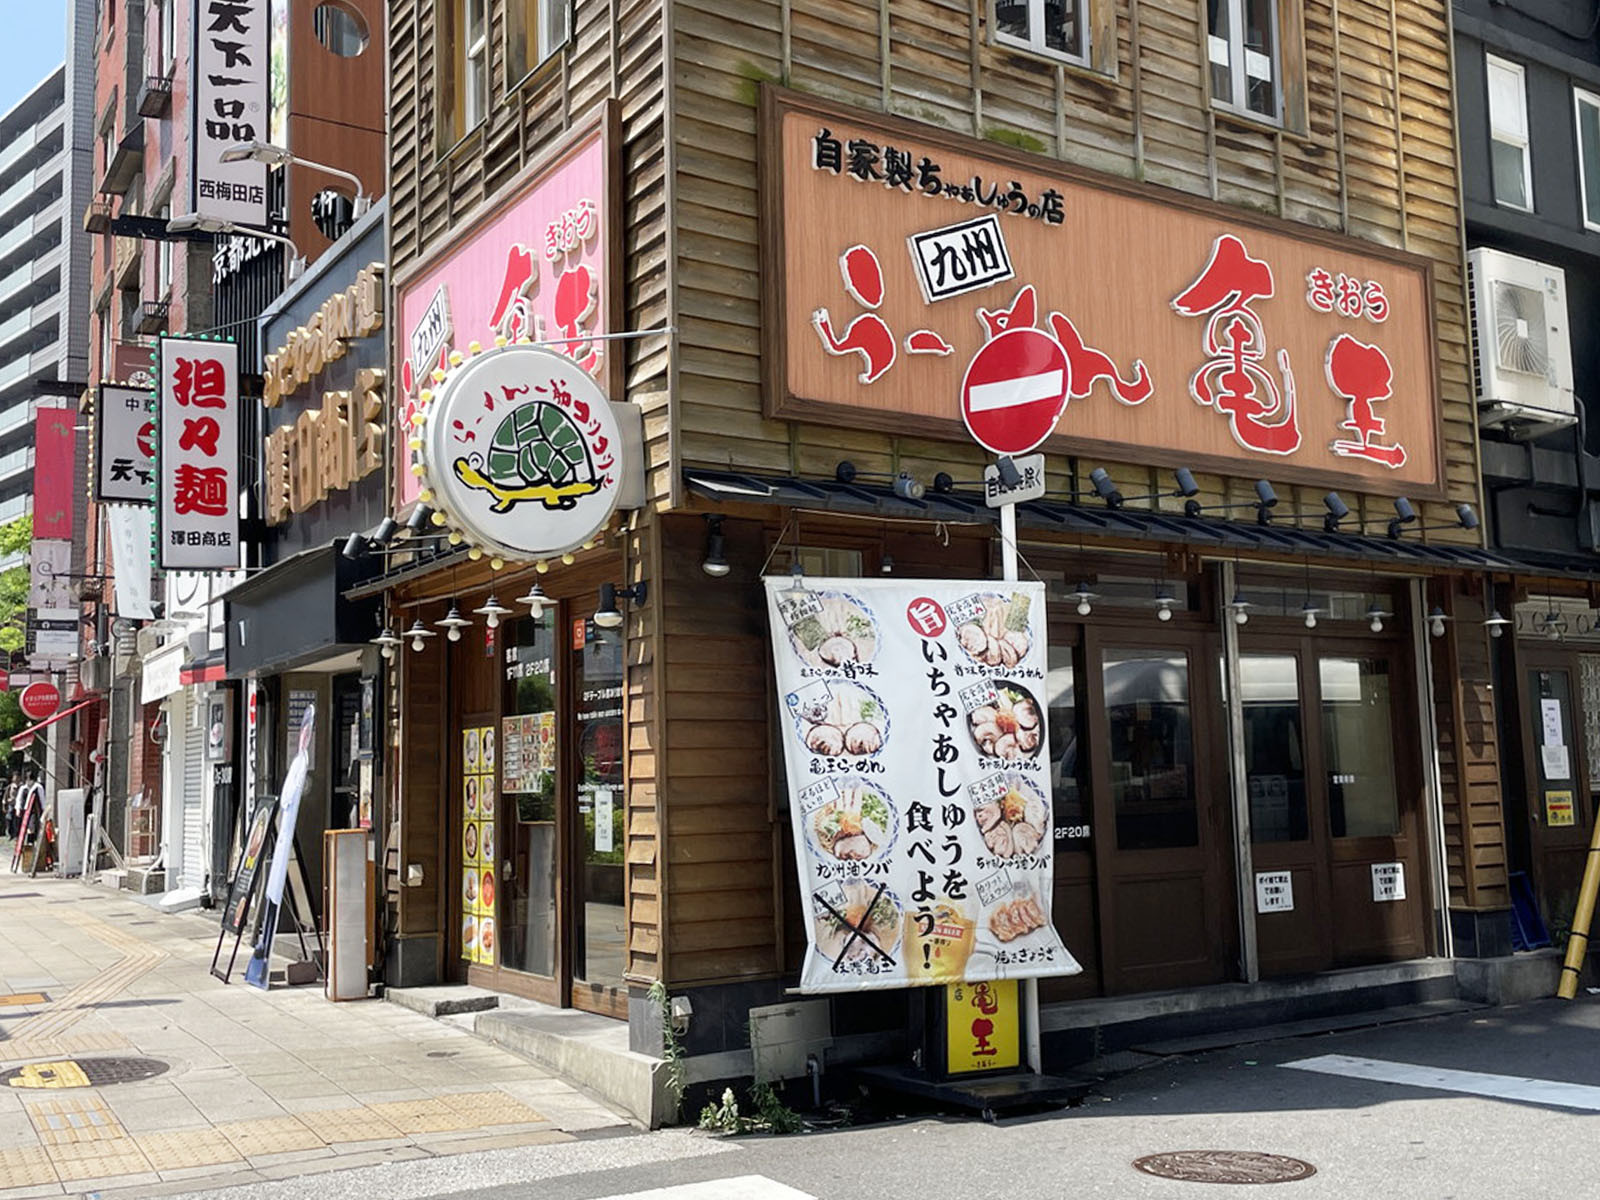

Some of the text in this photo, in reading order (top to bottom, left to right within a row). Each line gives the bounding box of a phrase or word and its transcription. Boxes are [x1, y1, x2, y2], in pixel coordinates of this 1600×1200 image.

[199, 178, 264, 206] 西梅田店
[931, 227, 1000, 287] 九州
[416, 297, 441, 368] 九州
[1172, 233, 1408, 470] 亀王
